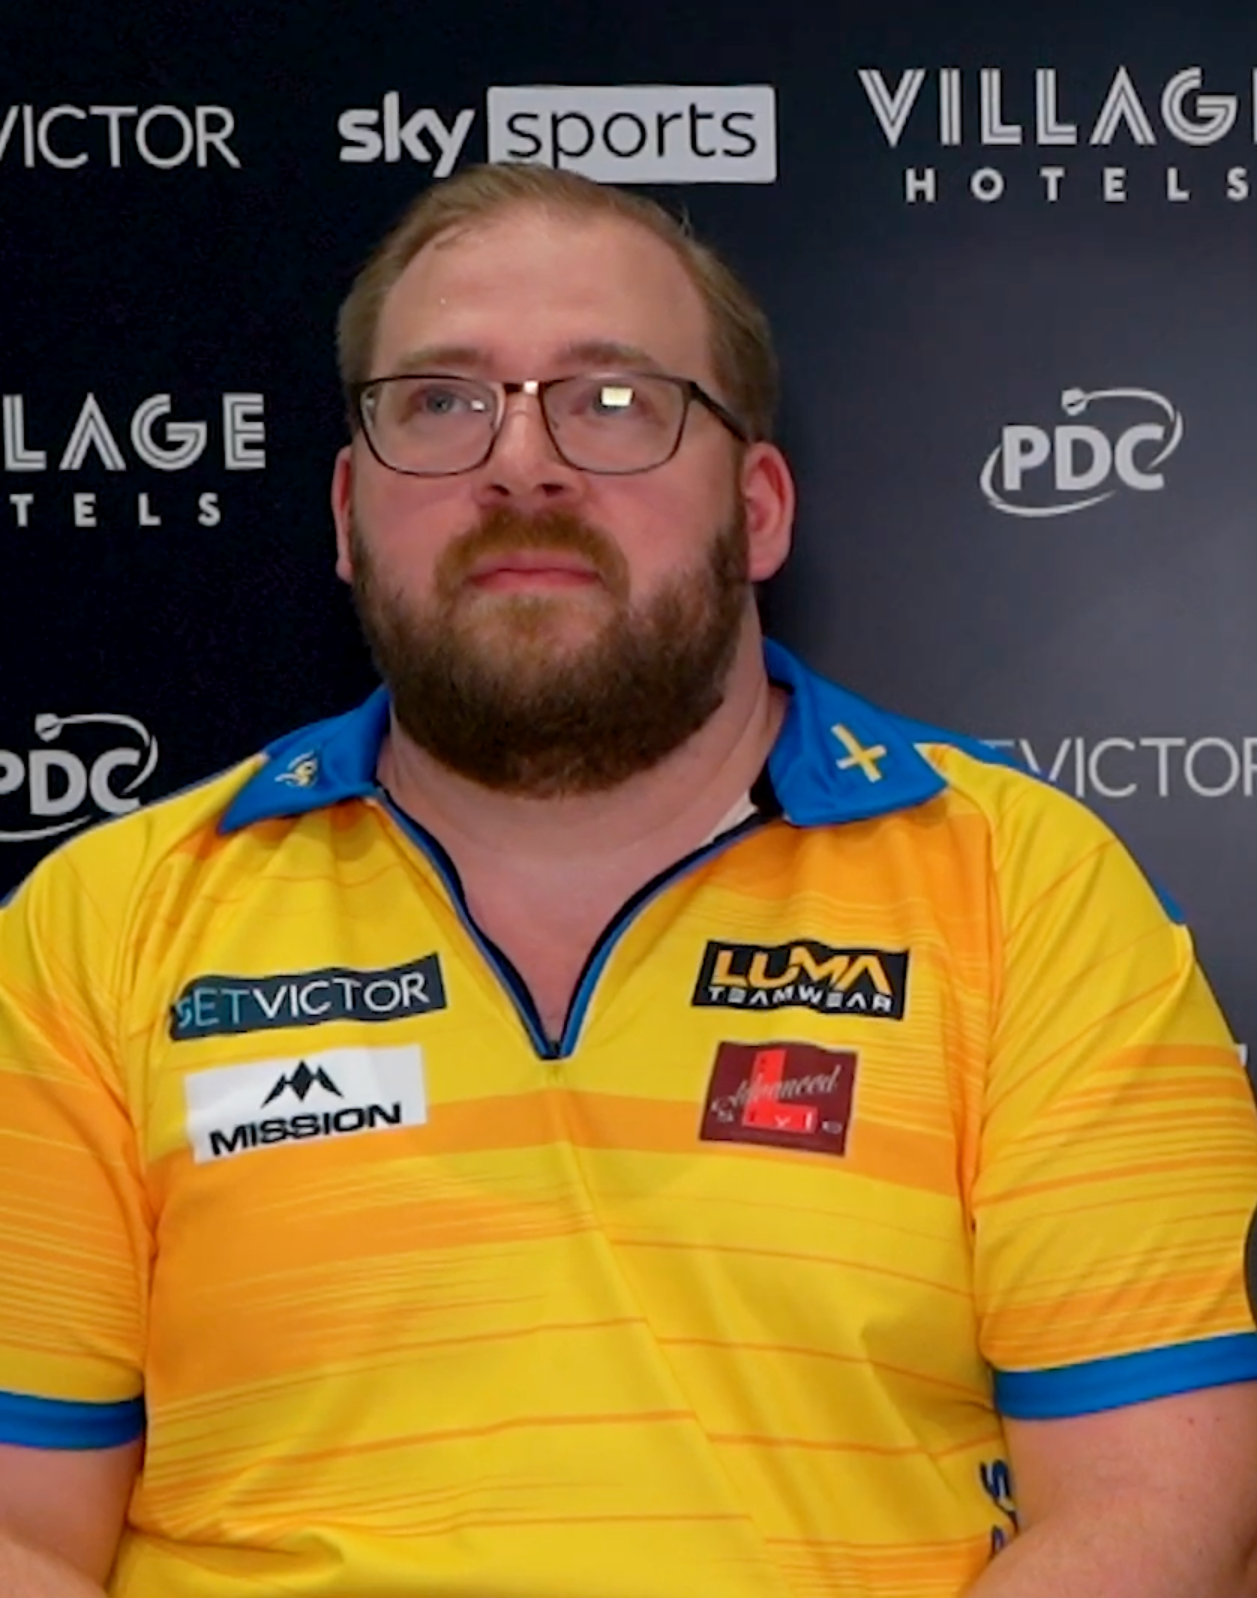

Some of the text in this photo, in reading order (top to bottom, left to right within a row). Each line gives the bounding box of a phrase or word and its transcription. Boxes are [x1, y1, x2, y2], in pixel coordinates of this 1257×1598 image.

[337, 91, 758, 178] sky sports
[905, 167, 1249, 202] HOTELS
[1002, 424, 1165, 492] PDC
[711, 946, 894, 996] LUMA
[209, 1101, 401, 1156] MISSION
